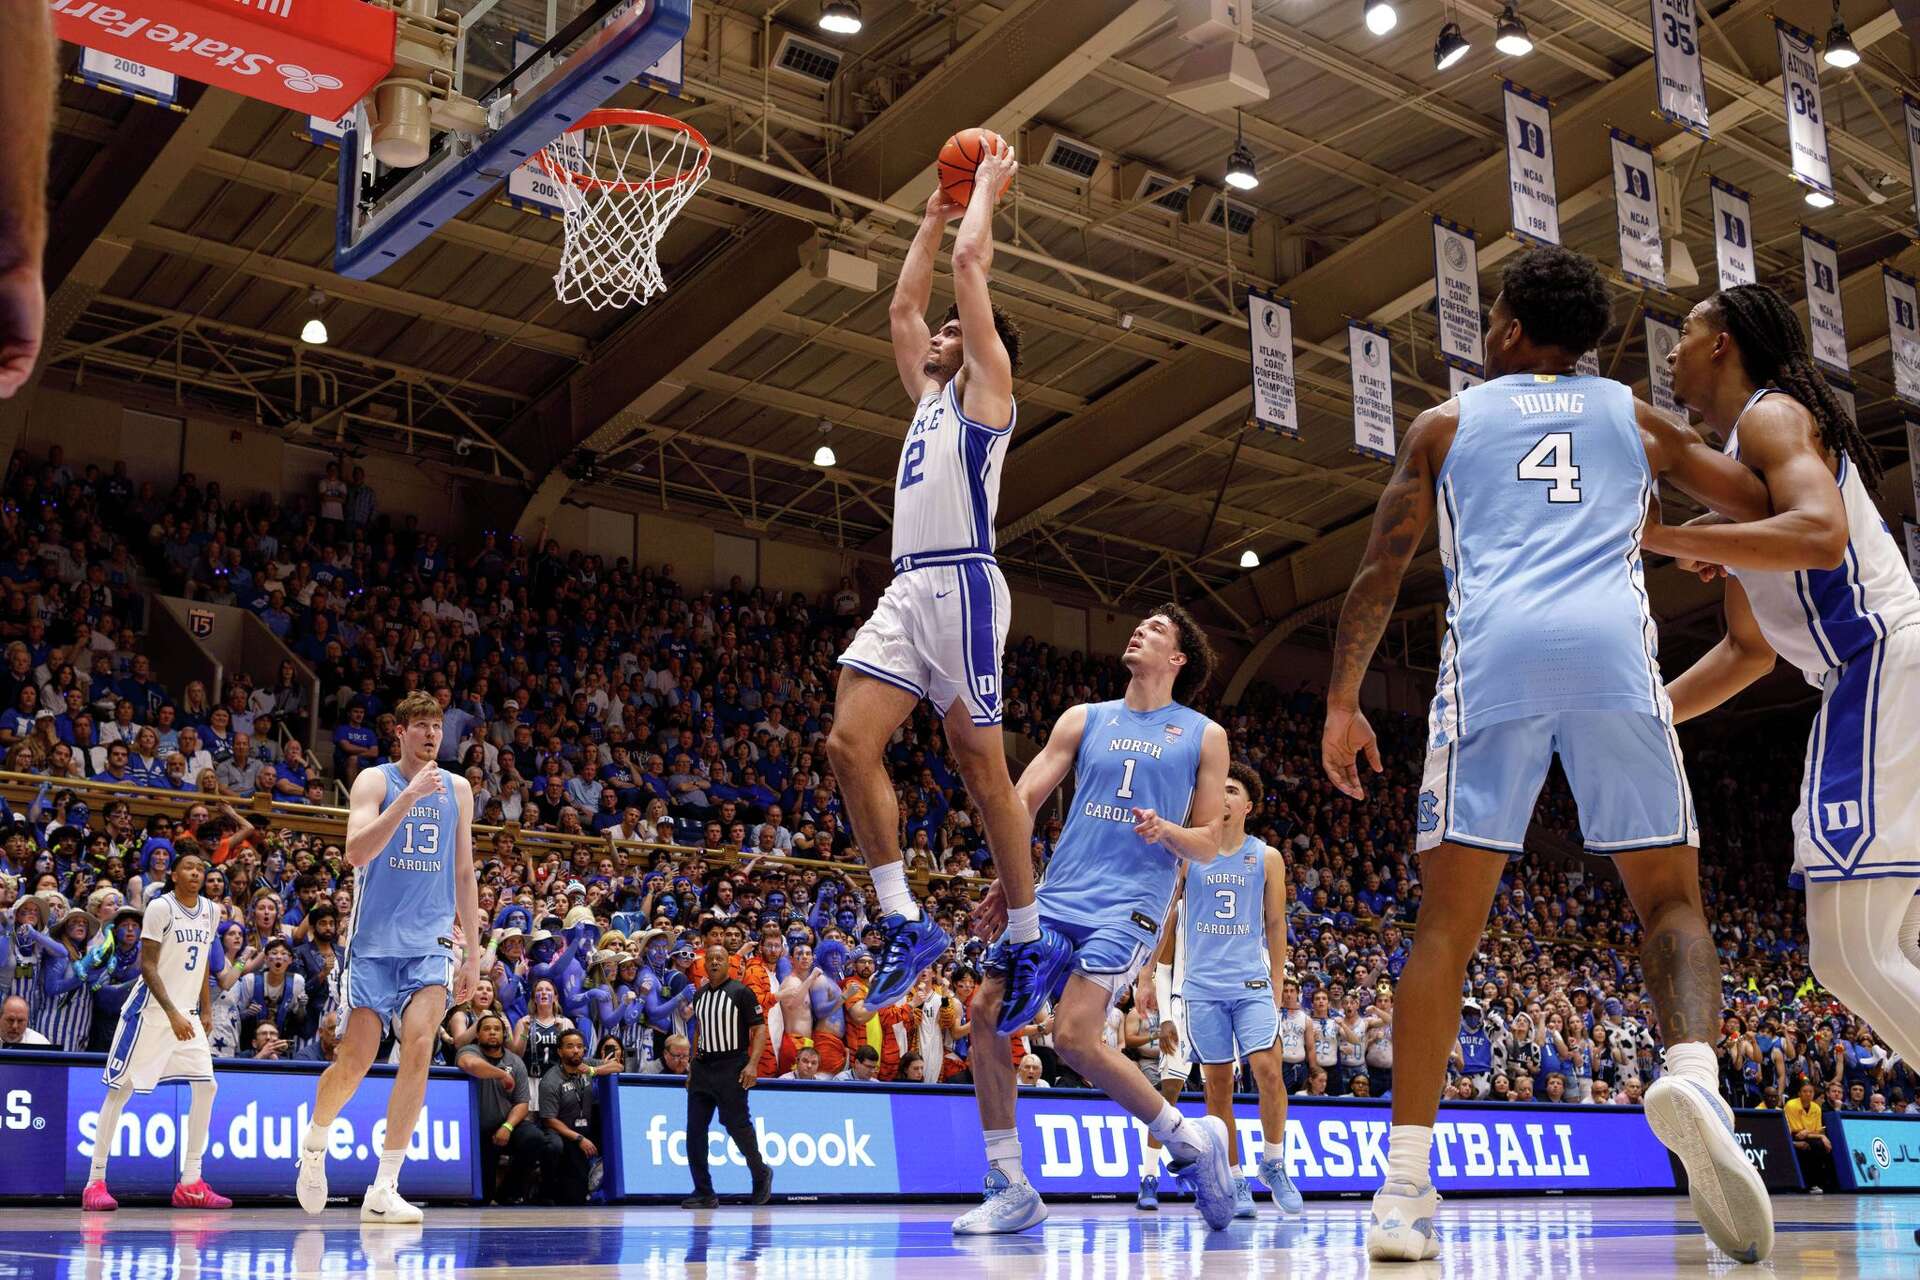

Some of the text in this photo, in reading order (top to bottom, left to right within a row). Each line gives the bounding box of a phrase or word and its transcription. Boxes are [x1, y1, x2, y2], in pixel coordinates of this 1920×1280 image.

[1662, 12, 1695, 56] 35
[114, 58, 146, 78] 2003
[1791, 82, 1818, 124] 32
[1523, 168, 1544, 184] NCAA
[1513, 182, 1535, 199] FINAL
[1630, 211, 1649, 226] NCAA
[1729, 257, 1746, 273] NCAA
[1445, 277, 1472, 295] ATLANTIC
[1449, 290, 1469, 304] COAST
[1440, 298, 1480, 320] CONFERENCE
[1443, 311, 1479, 332] CHAMPIONS
[1259, 346, 1287, 363] ATLANTIC
[1264, 359, 1284, 372] COAST
[1255, 366, 1295, 387] CONFERENCE
[1359, 374, 1386, 391] ATLANTIC
[1257, 378, 1294, 397] CHAMPIONS
[1354, 395, 1392, 415] CONFERENCE
[1511, 393, 1585, 416] YOUNG
[912, 408, 945, 435] KE
[900, 439, 926, 489] 2
[1517, 432, 1582, 503] 4
[193, 616, 211, 633] 15
[1108, 739, 1163, 759] NORTH
[1116, 758, 1136, 799] 1
[1085, 802, 1138, 824] CAROL
[402, 823, 440, 854] 13
[389, 856, 441, 871] CAROLIN
[1207, 873, 1245, 887] NORTH
[1215, 889, 1236, 919] 3
[175, 928, 210, 944] DUKE
[1197, 922, 1250, 935] CAROLINA
[185, 945, 199, 971] 3
[1460, 1035, 1485, 1046] DUKE
[1545, 1044, 1552, 1056] 1
[1470, 1044, 1475, 1057] 1
[646, 1114, 877, 1167] facebook
[1235, 1118, 1590, 1178] BASKTBALL
[1893, 1144, 1920, 1162] JL
